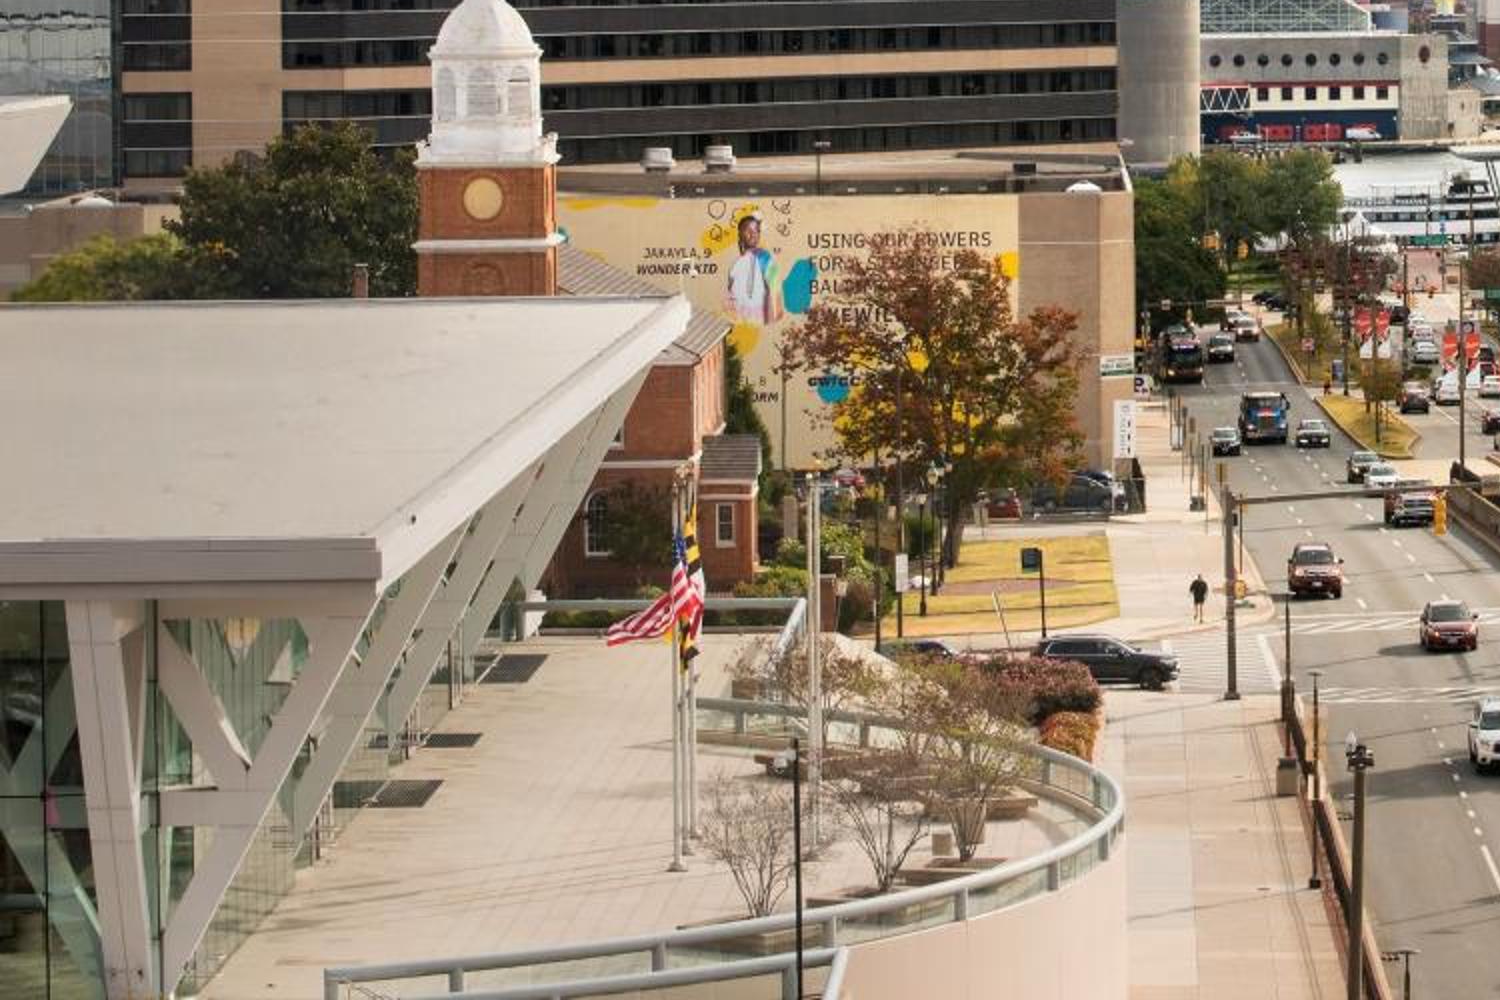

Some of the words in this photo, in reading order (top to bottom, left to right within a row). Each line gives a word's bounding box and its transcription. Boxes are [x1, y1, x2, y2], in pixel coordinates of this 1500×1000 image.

[807, 232, 865, 249] USING
[914, 231, 991, 248] POWERS
[704, 247, 713, 259] 9
[637, 263, 690, 276] WONDER
[809, 255, 844, 272] FOR
